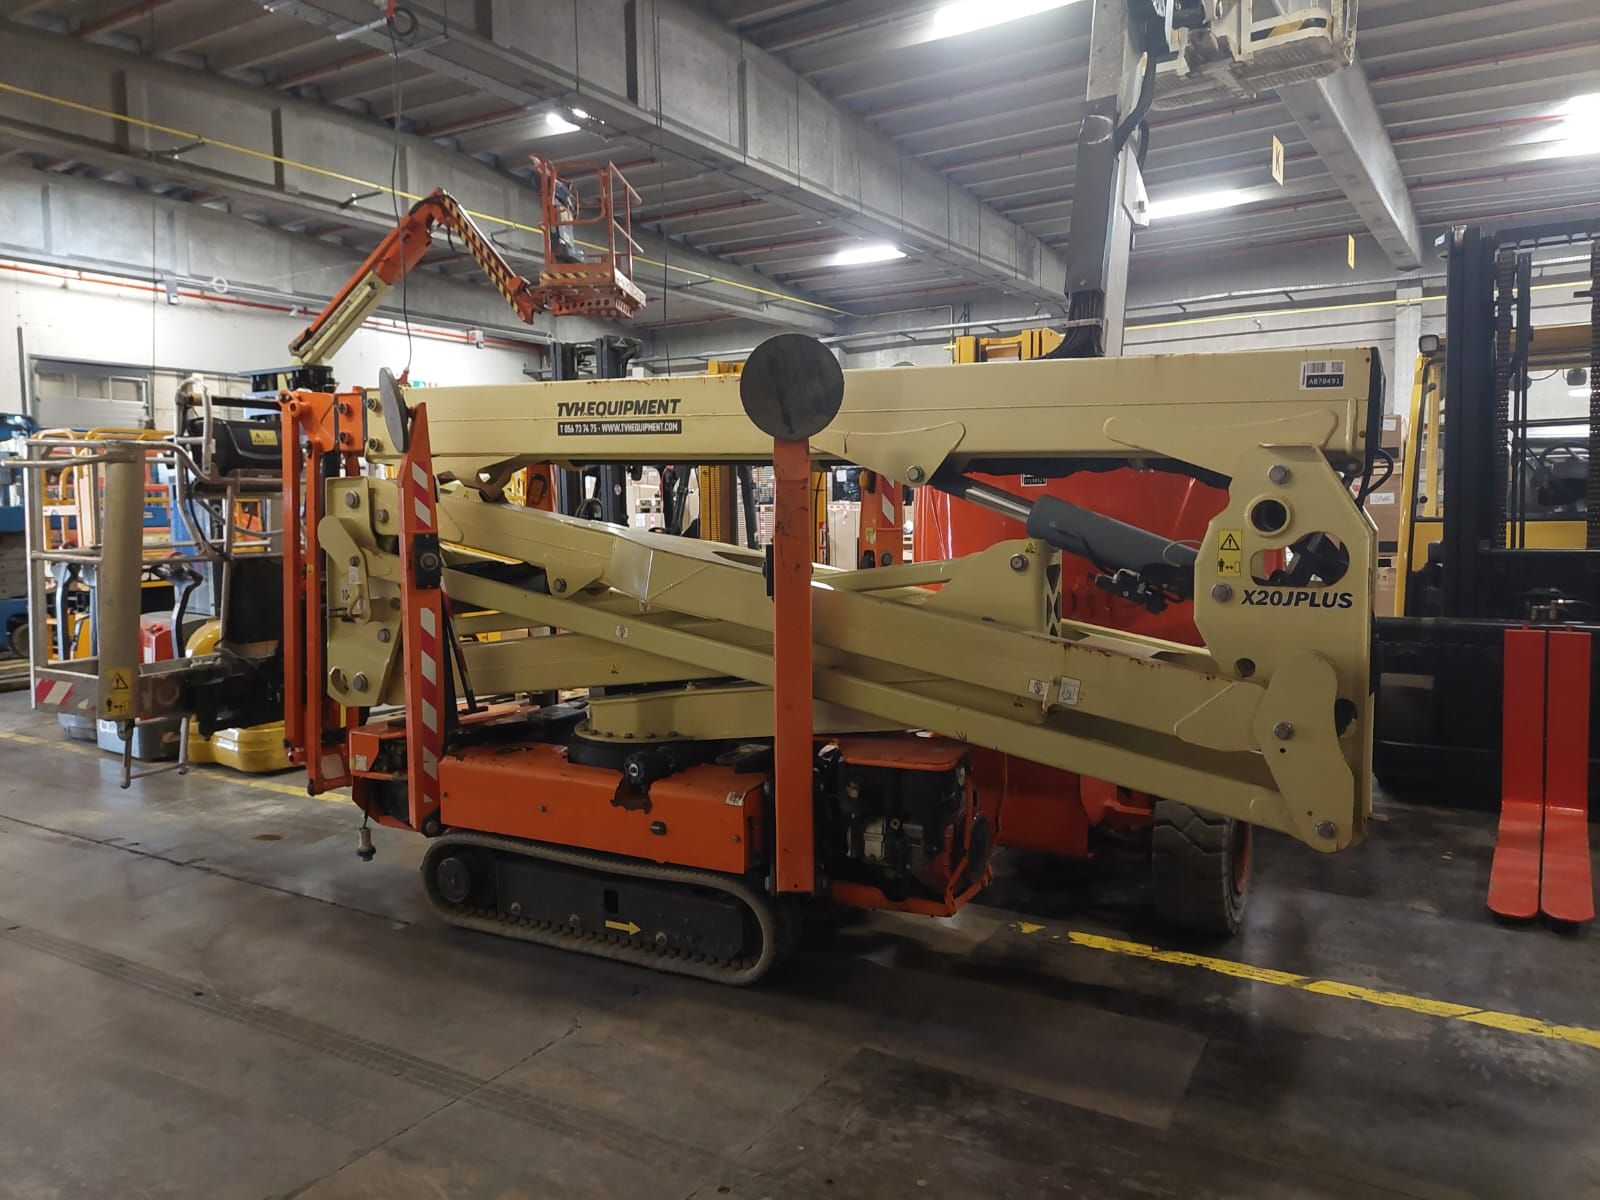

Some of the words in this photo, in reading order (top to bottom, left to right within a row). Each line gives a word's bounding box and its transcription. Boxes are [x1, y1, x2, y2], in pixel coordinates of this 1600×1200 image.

[590, 423, 597, 433] 75
[601, 422, 678, 433] WWW.TVHEQUIPMENT.COM
[1241, 589, 1353, 608] X20JPLUS
